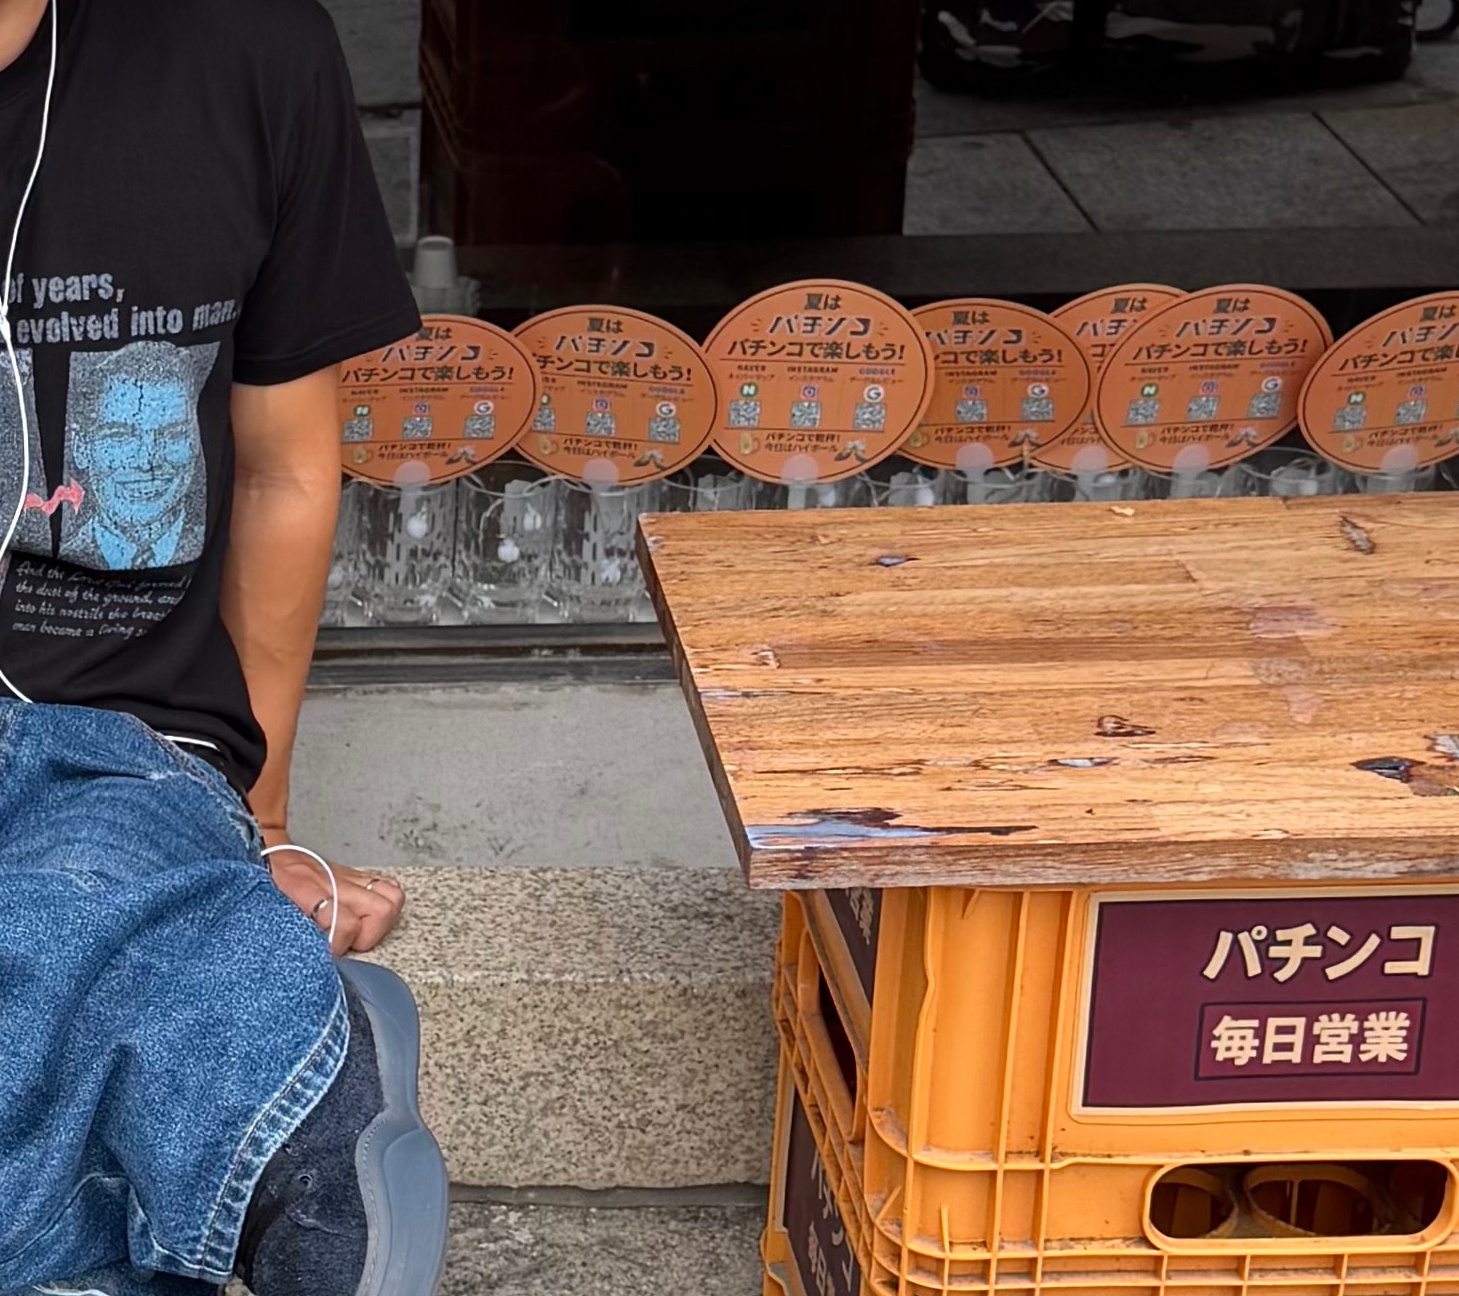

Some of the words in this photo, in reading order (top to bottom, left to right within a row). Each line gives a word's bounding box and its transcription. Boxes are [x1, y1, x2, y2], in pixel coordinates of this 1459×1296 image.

[32, 273, 125, 309] years,
[805, 293, 841, 310] 夏は
[1111, 298, 1148, 313] 夏は
[1213, 298, 1250, 314] 夏は
[952, 311, 990, 325] 夏は
[1420, 305, 1457, 322] 夏は
[17, 308, 119, 343] evolved
[131, 306, 183, 336] into
[588, 318, 624, 332] 夏は
[769, 317, 871, 336] パチンコ
[1077, 319, 1137, 336] パチ
[1176, 317, 1277, 337] パチンコ
[416, 327, 452, 341] 夏は
[382, 346, 481, 361] パチンコ
[556, 336, 654, 358] パチンコ
[728, 340, 904, 360] パチンコで楽しもう!
[1133, 340, 1308, 360] パチンコで楽しもう!
[342, 367, 513, 382] パチンコで楽しもう!
[533, 353, 691, 381] チンコで楽しもう!
[39, 601, 55, 615] his
[1202, 923, 1435, 982] パチンコ
[1211, 1011, 1411, 1066] 毎日営業
